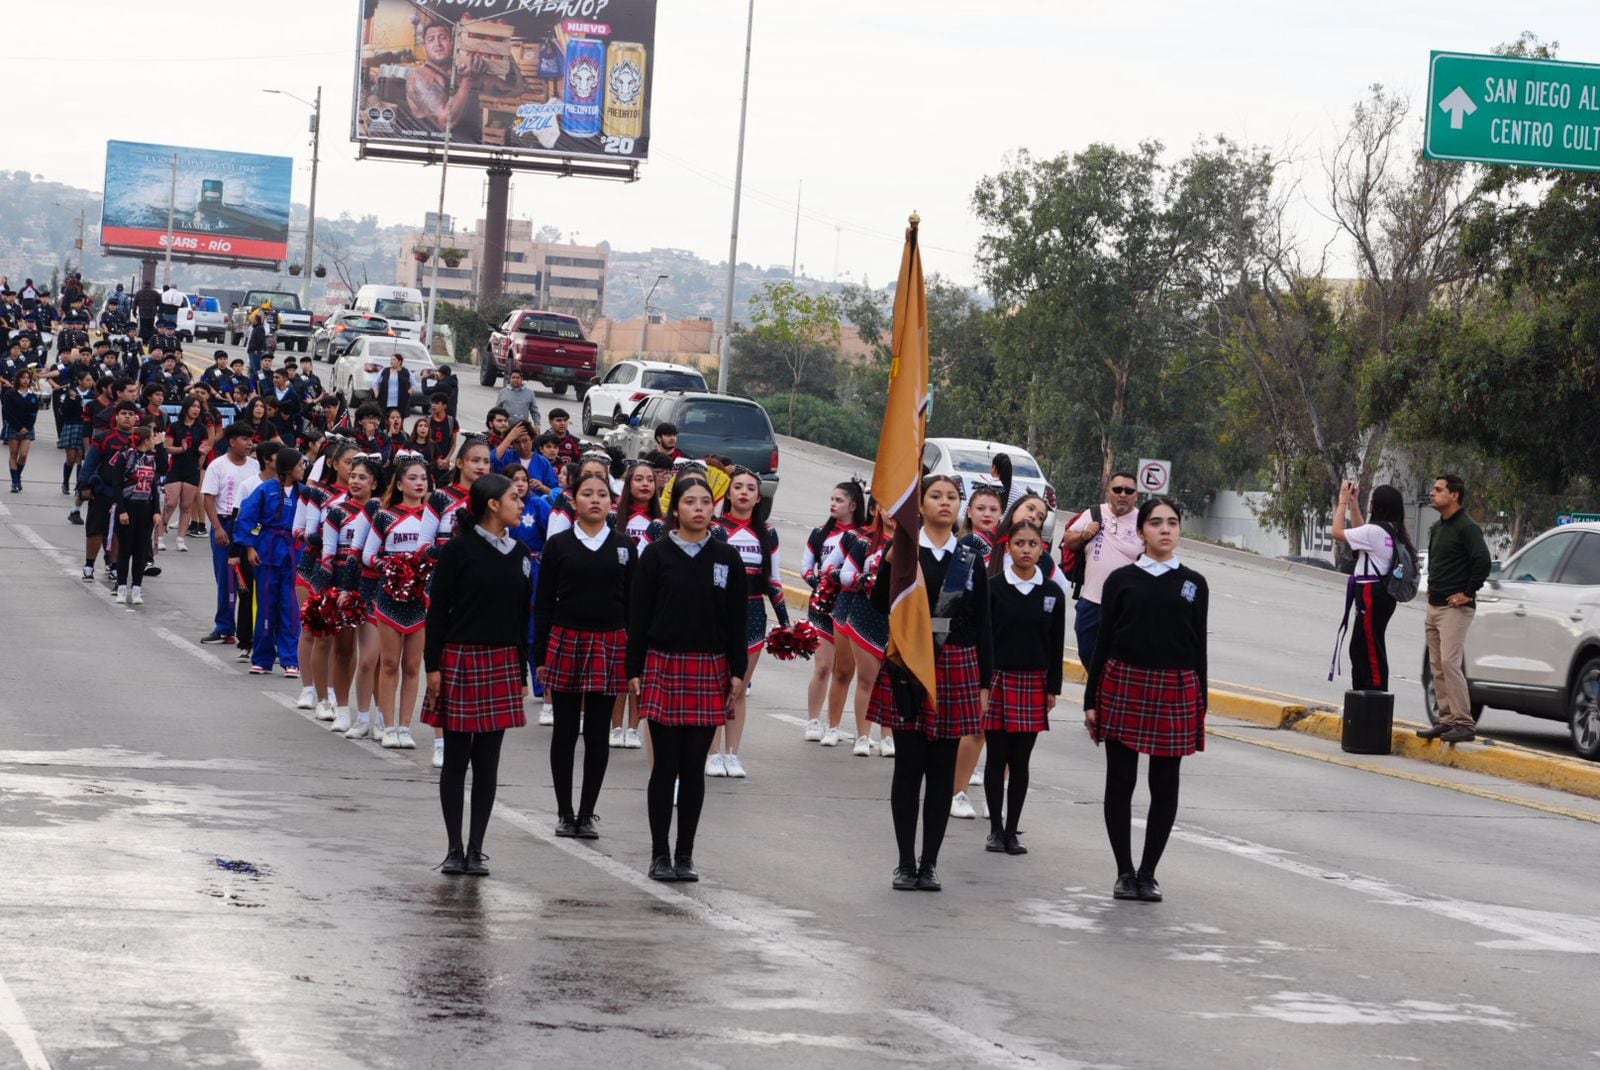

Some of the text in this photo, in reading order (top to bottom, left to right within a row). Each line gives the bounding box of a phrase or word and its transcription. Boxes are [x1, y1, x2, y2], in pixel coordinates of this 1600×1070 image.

[567, 22, 606, 34] NUEVO
[1484, 76, 1517, 104] SAN
[1525, 80, 1571, 109] DIEGO
[518, 114, 554, 131] AZUL
[1491, 118, 1600, 151] CENTRO CULT
[601, 135, 635, 154] $20
[208, 239, 232, 252] RÍO
